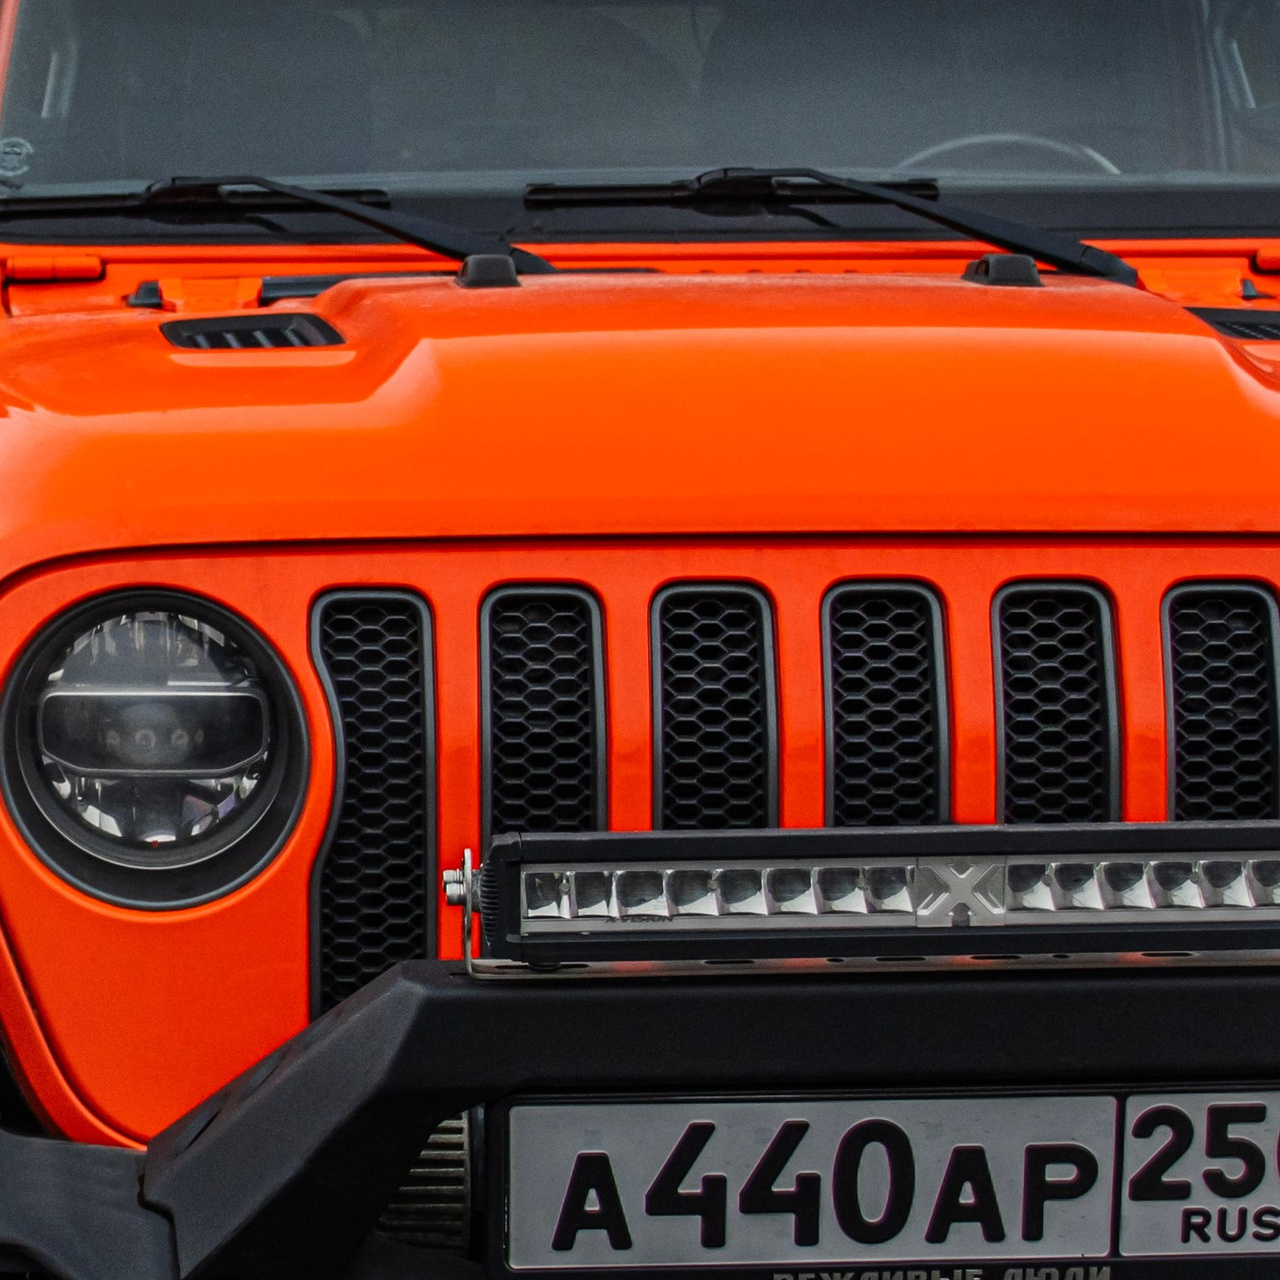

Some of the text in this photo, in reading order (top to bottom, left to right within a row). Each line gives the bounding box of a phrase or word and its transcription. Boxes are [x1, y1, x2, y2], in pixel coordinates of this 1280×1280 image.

[551, 1102, 1280, 1250] А440АР 25
[1180, 1206, 1280, 1243] RUS
